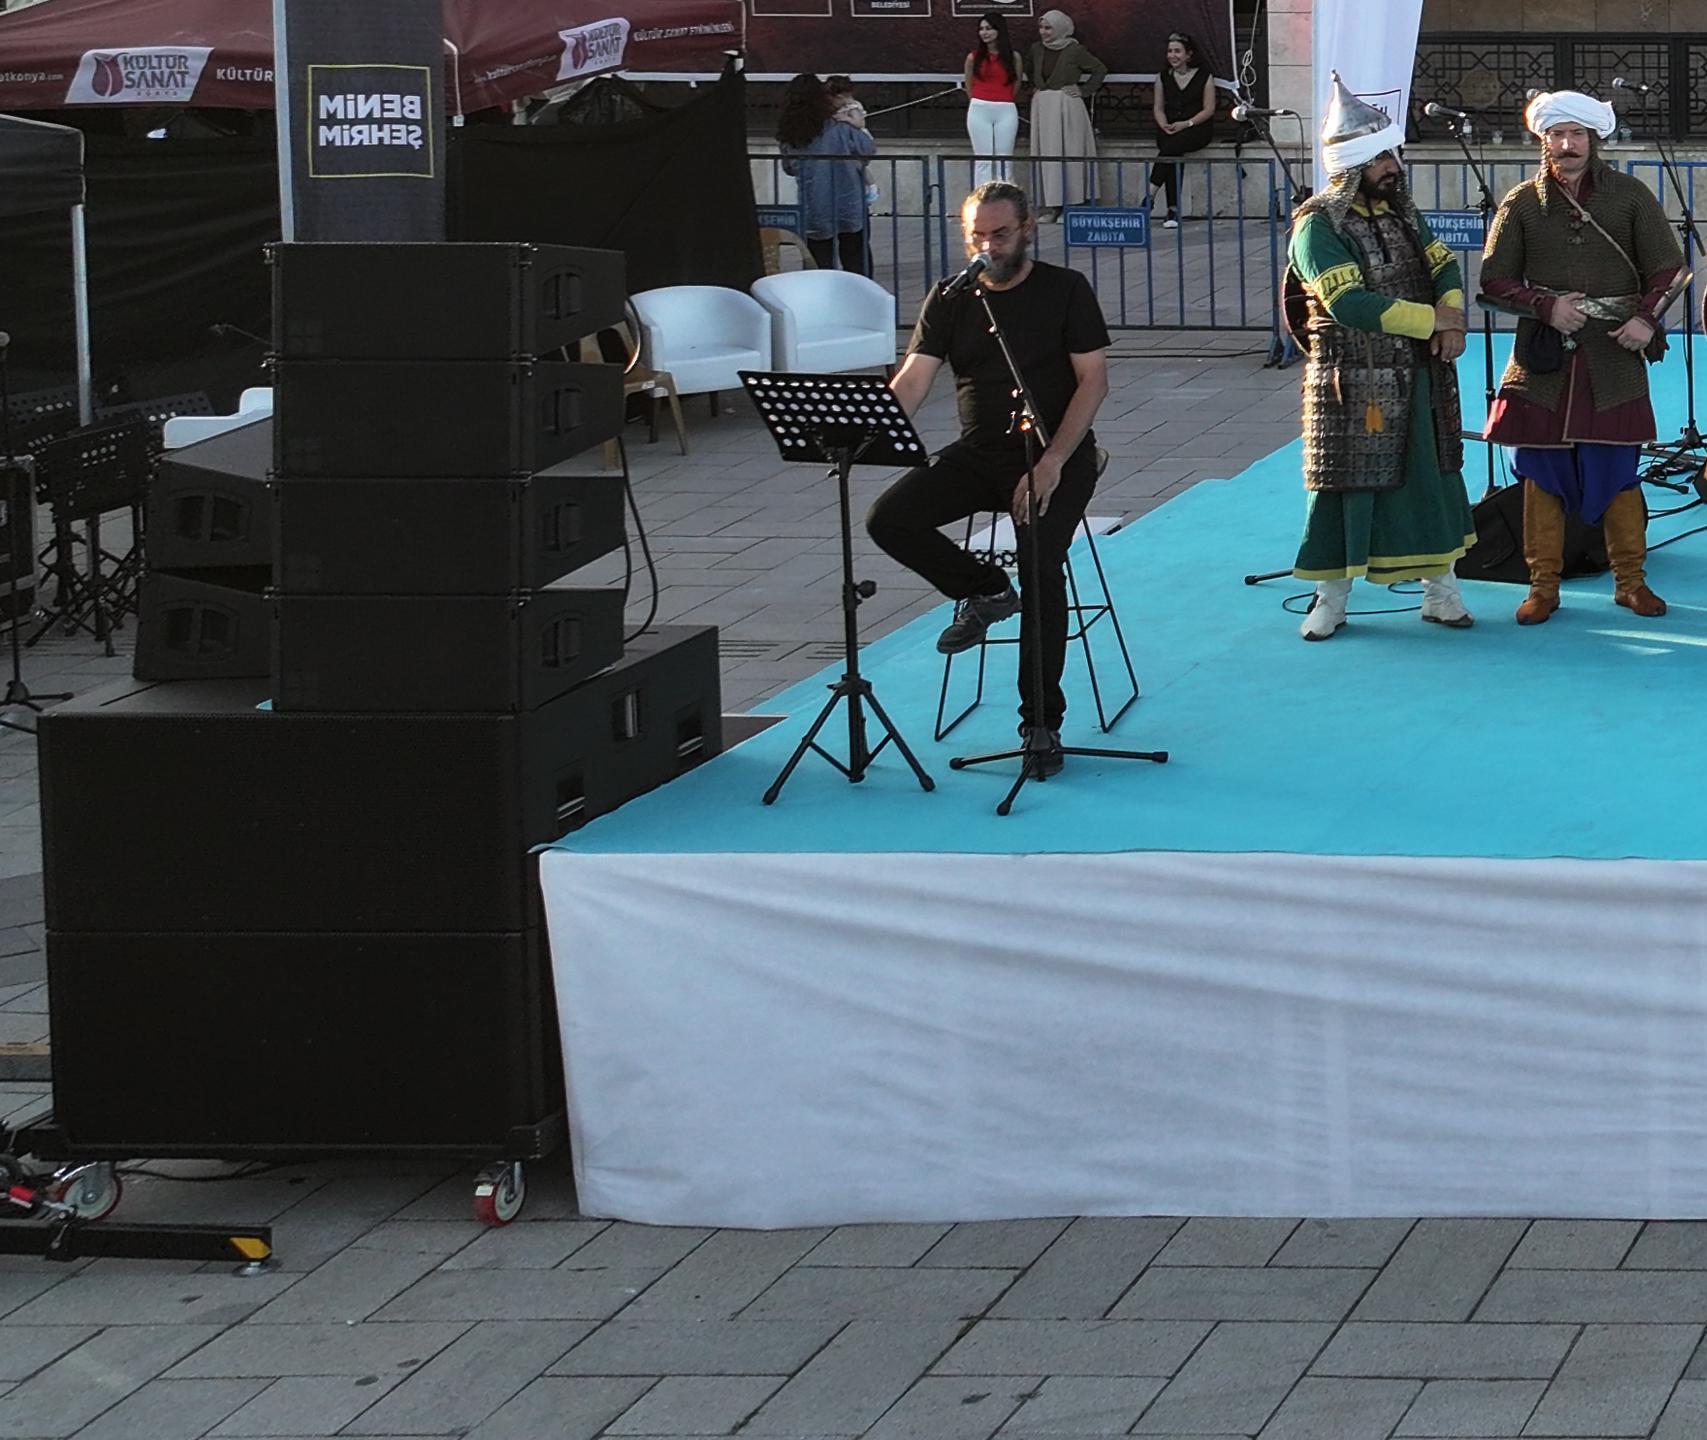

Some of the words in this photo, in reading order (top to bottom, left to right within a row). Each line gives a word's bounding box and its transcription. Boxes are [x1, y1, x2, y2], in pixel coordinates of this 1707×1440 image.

[124, 70, 190, 89] SANAT
[216, 67, 275, 83] KÜLTÜR
[1071, 215, 1141, 230] BÜYÜKŞEHİR
